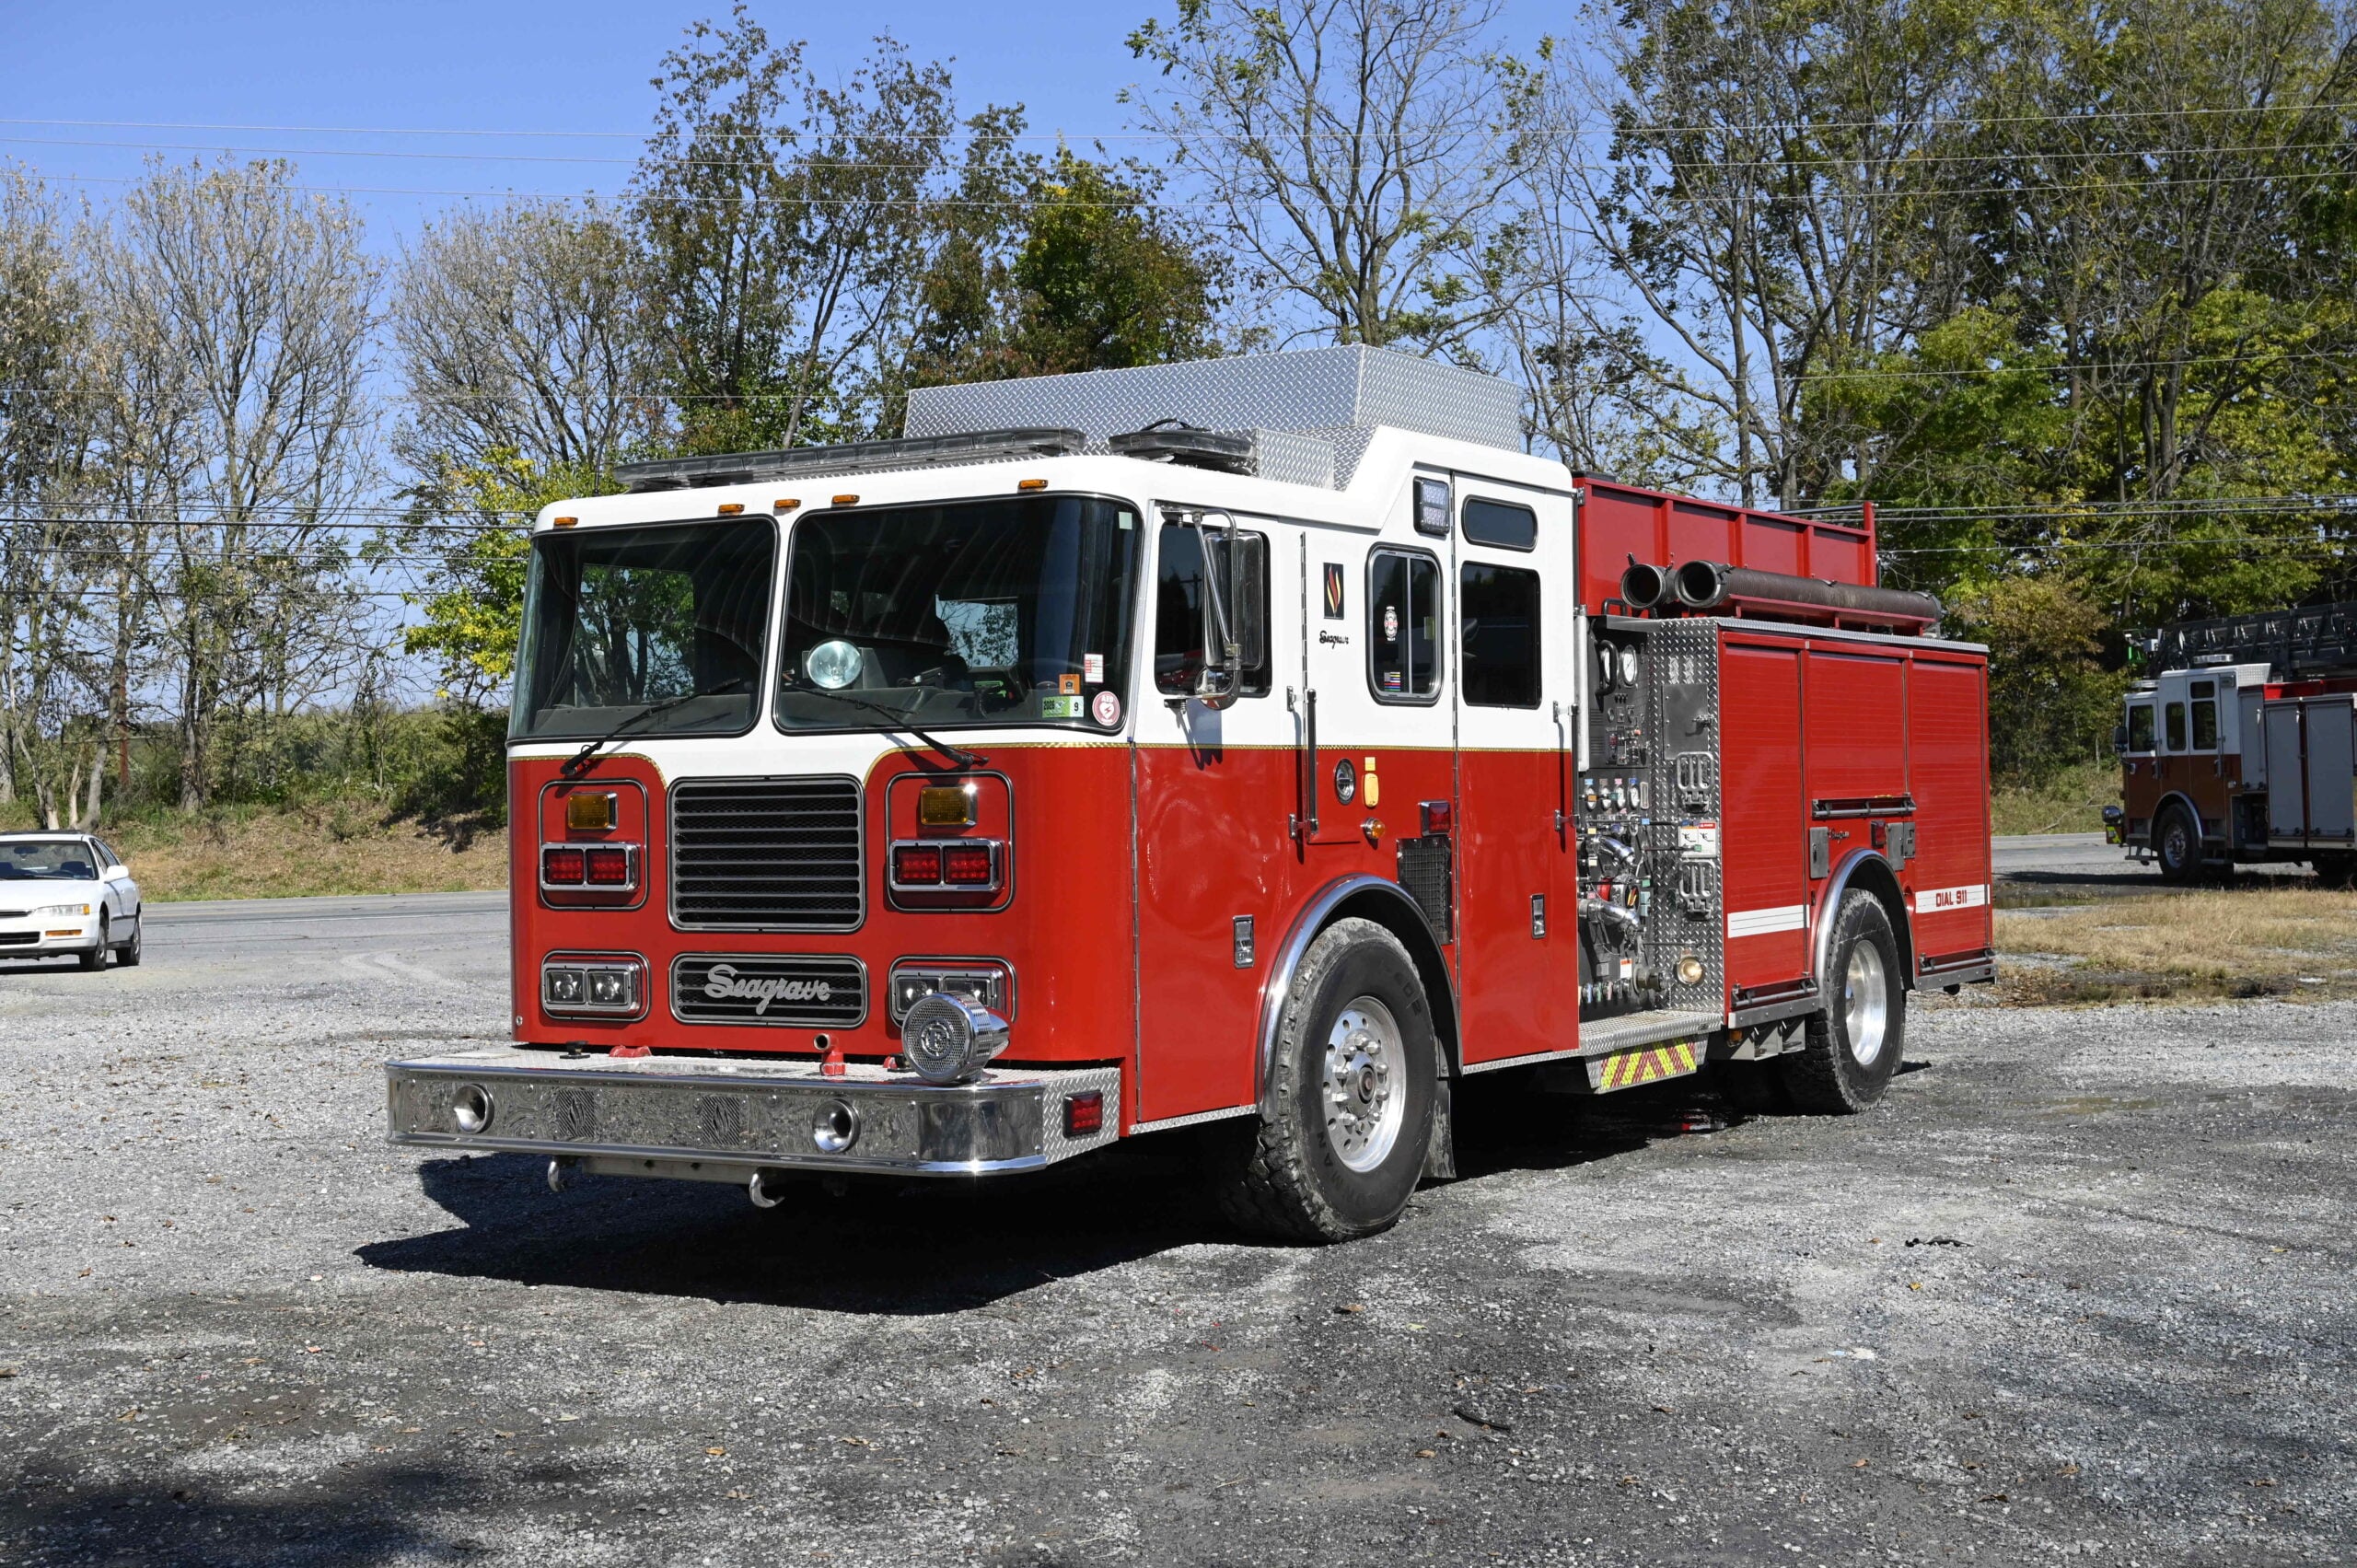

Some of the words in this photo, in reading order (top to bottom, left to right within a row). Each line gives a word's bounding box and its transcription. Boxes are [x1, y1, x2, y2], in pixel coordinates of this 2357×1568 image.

[1074, 702, 1079, 712] 9
[1935, 891, 1954, 908] DIAL
[1956, 889, 1968, 905] 911
[704, 964, 830, 1015] Seagrave
